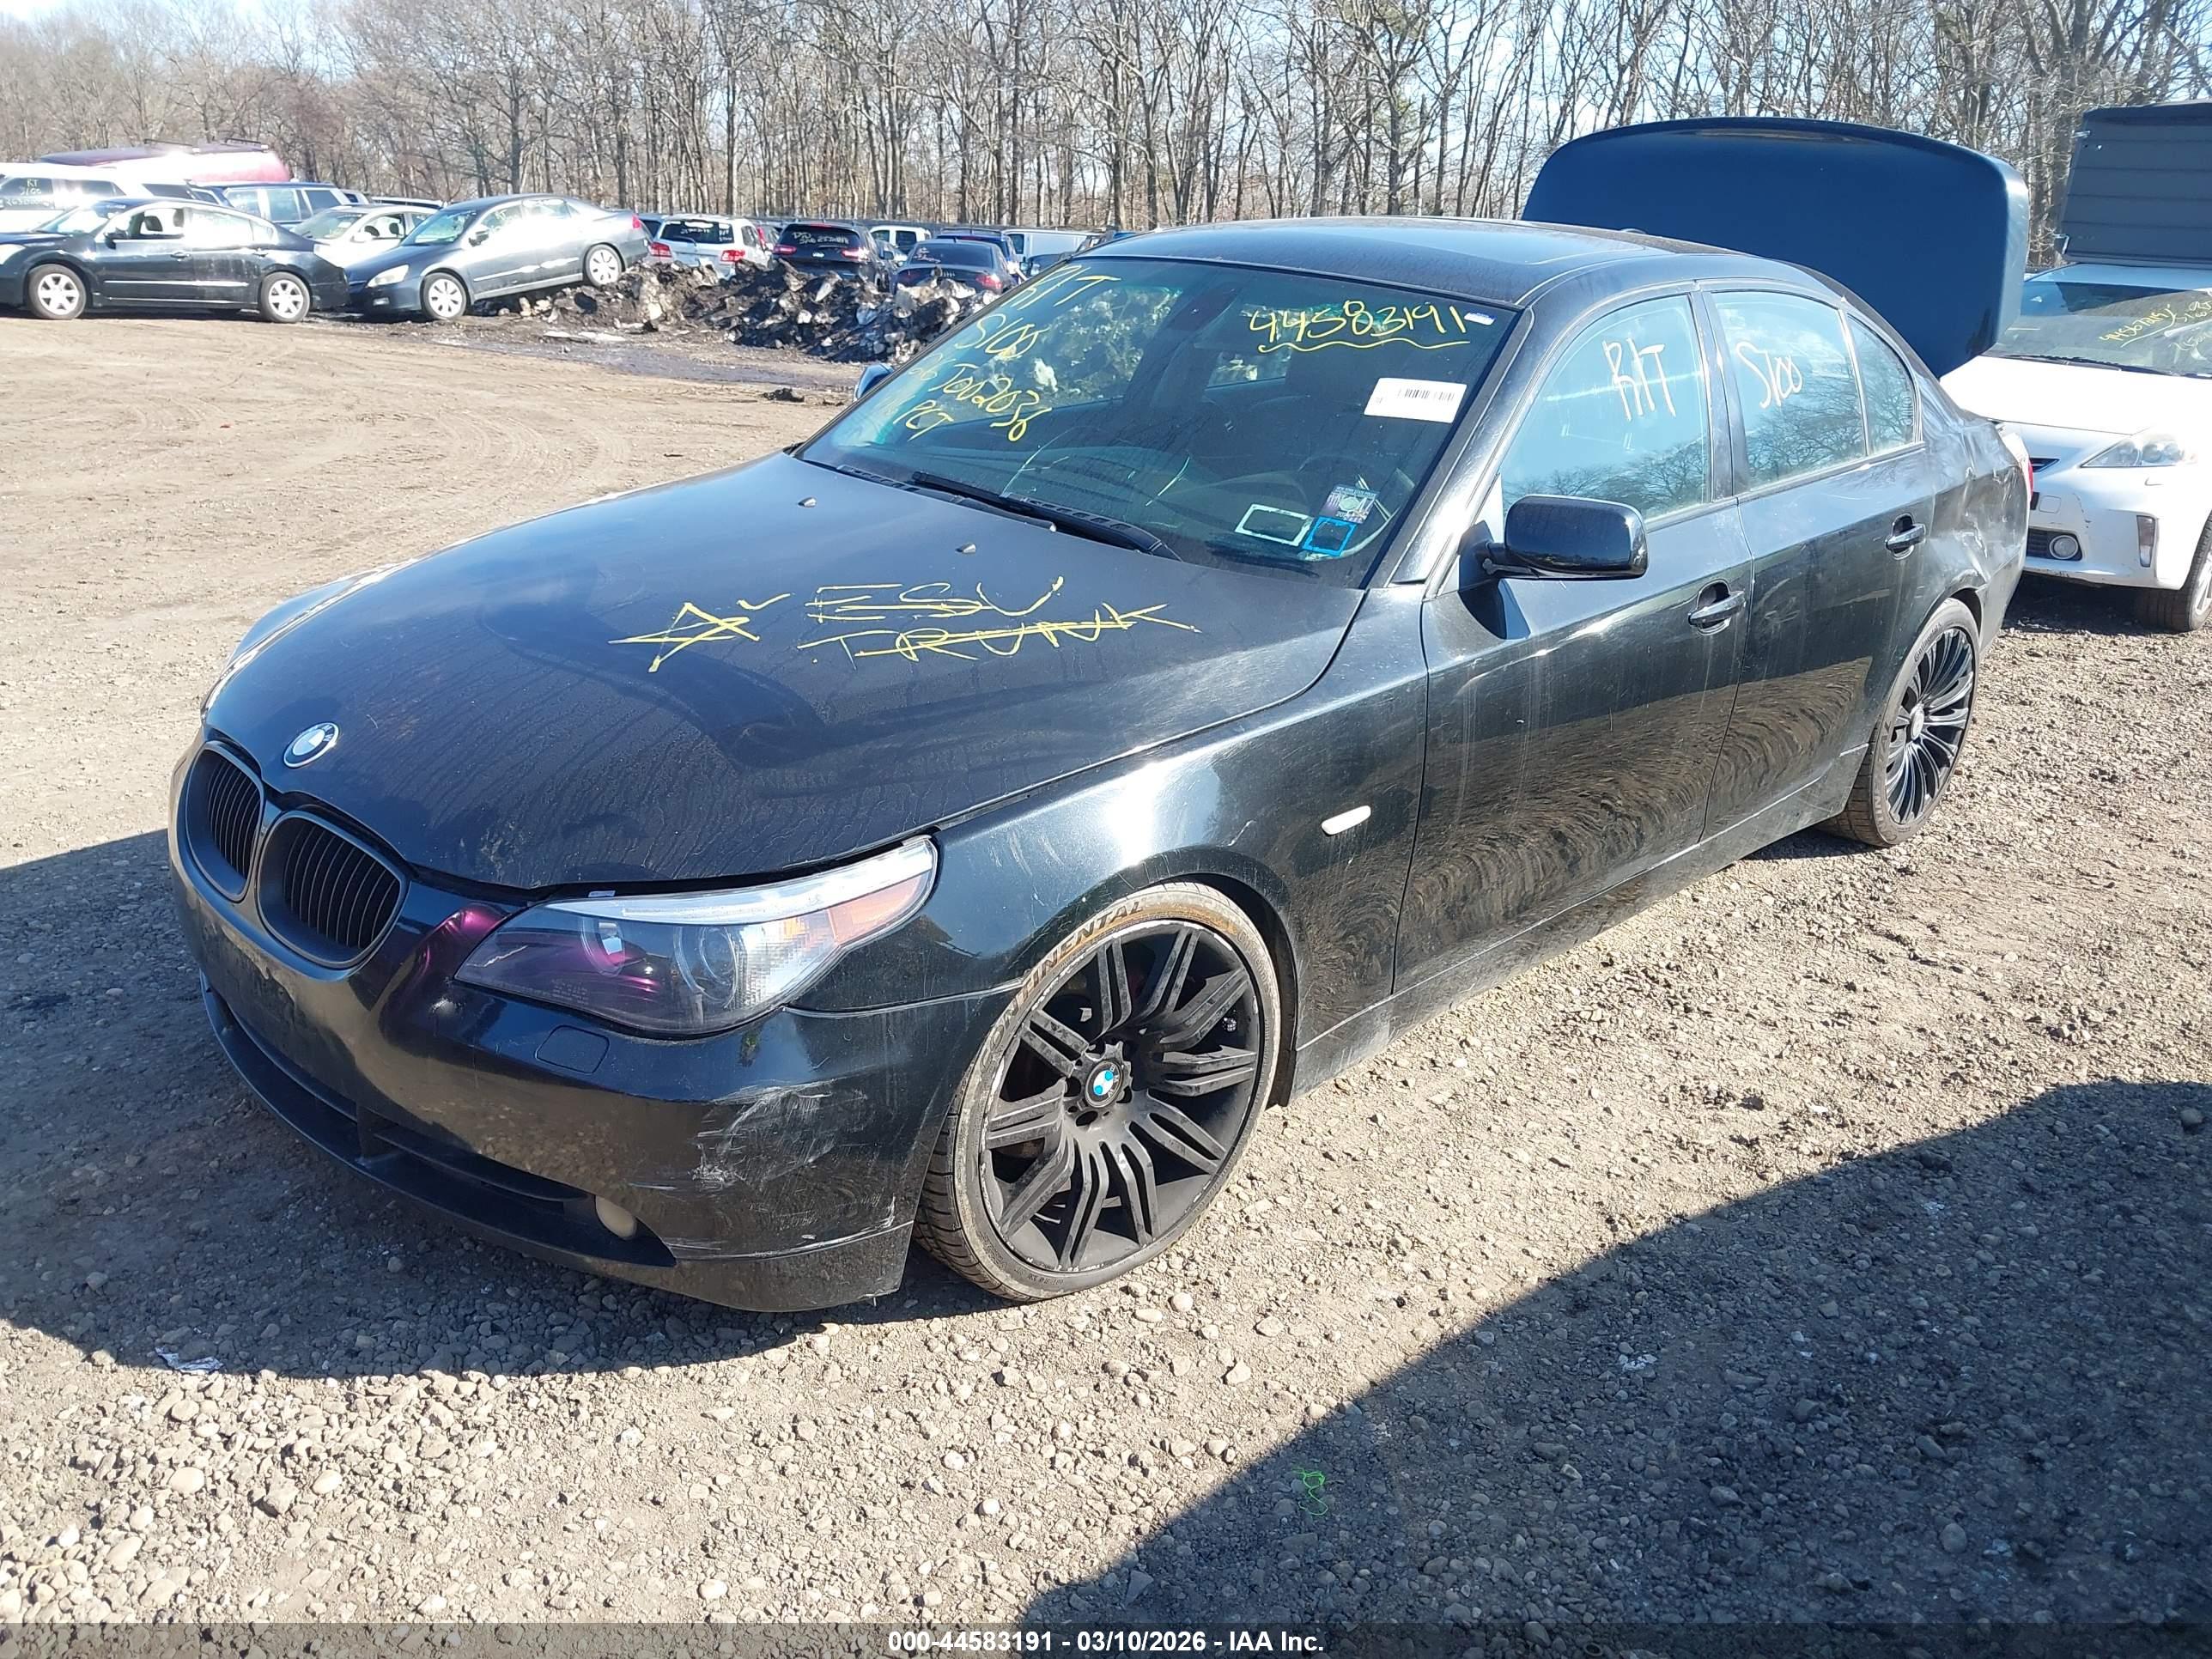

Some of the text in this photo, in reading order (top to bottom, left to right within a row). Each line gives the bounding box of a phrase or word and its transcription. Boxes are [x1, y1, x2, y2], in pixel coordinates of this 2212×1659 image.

[1249, 301, 1467, 343] 44583191
[797, 603, 1202, 671] TRUNK
[981, 901, 1143, 1067] CONTINENTAL
